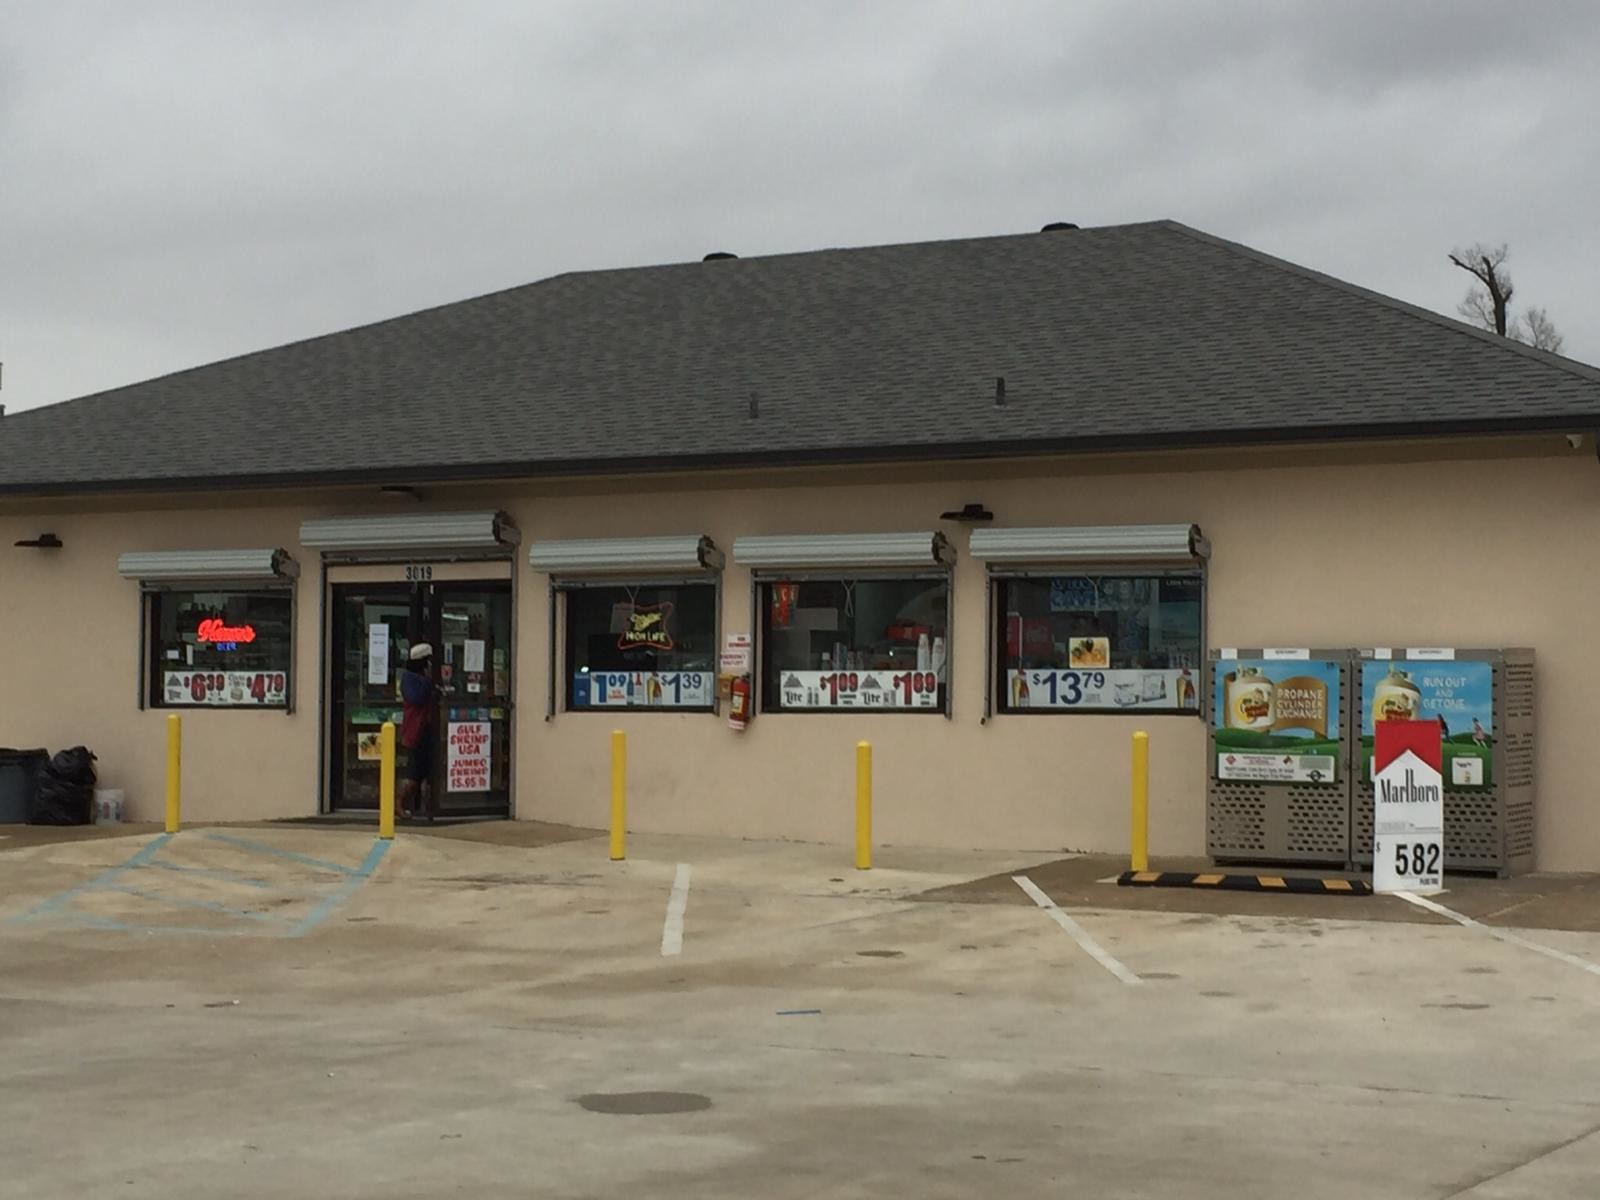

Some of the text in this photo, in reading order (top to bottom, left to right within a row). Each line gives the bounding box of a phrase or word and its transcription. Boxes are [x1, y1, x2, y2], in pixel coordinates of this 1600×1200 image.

[405, 565, 432, 580] 3019
[1423, 677, 1467, 688] RUN OUT
[785, 691, 803, 705] Lite
[1277, 688, 1322, 700] PROPANE
[1435, 688, 1454, 697] AND
[861, 692, 881, 705] Lite
[1423, 698, 1465, 709] GET ONE
[1276, 700, 1322, 710] CYLINDER
[1276, 709, 1322, 719] EXCHANGE
[456, 725, 482, 735] GULF
[450, 735, 489, 745] SHRIMP
[458, 744, 480, 755] USA
[452, 759, 487, 768] JUMBO
[1380, 768, 1439, 803] Marlboro
